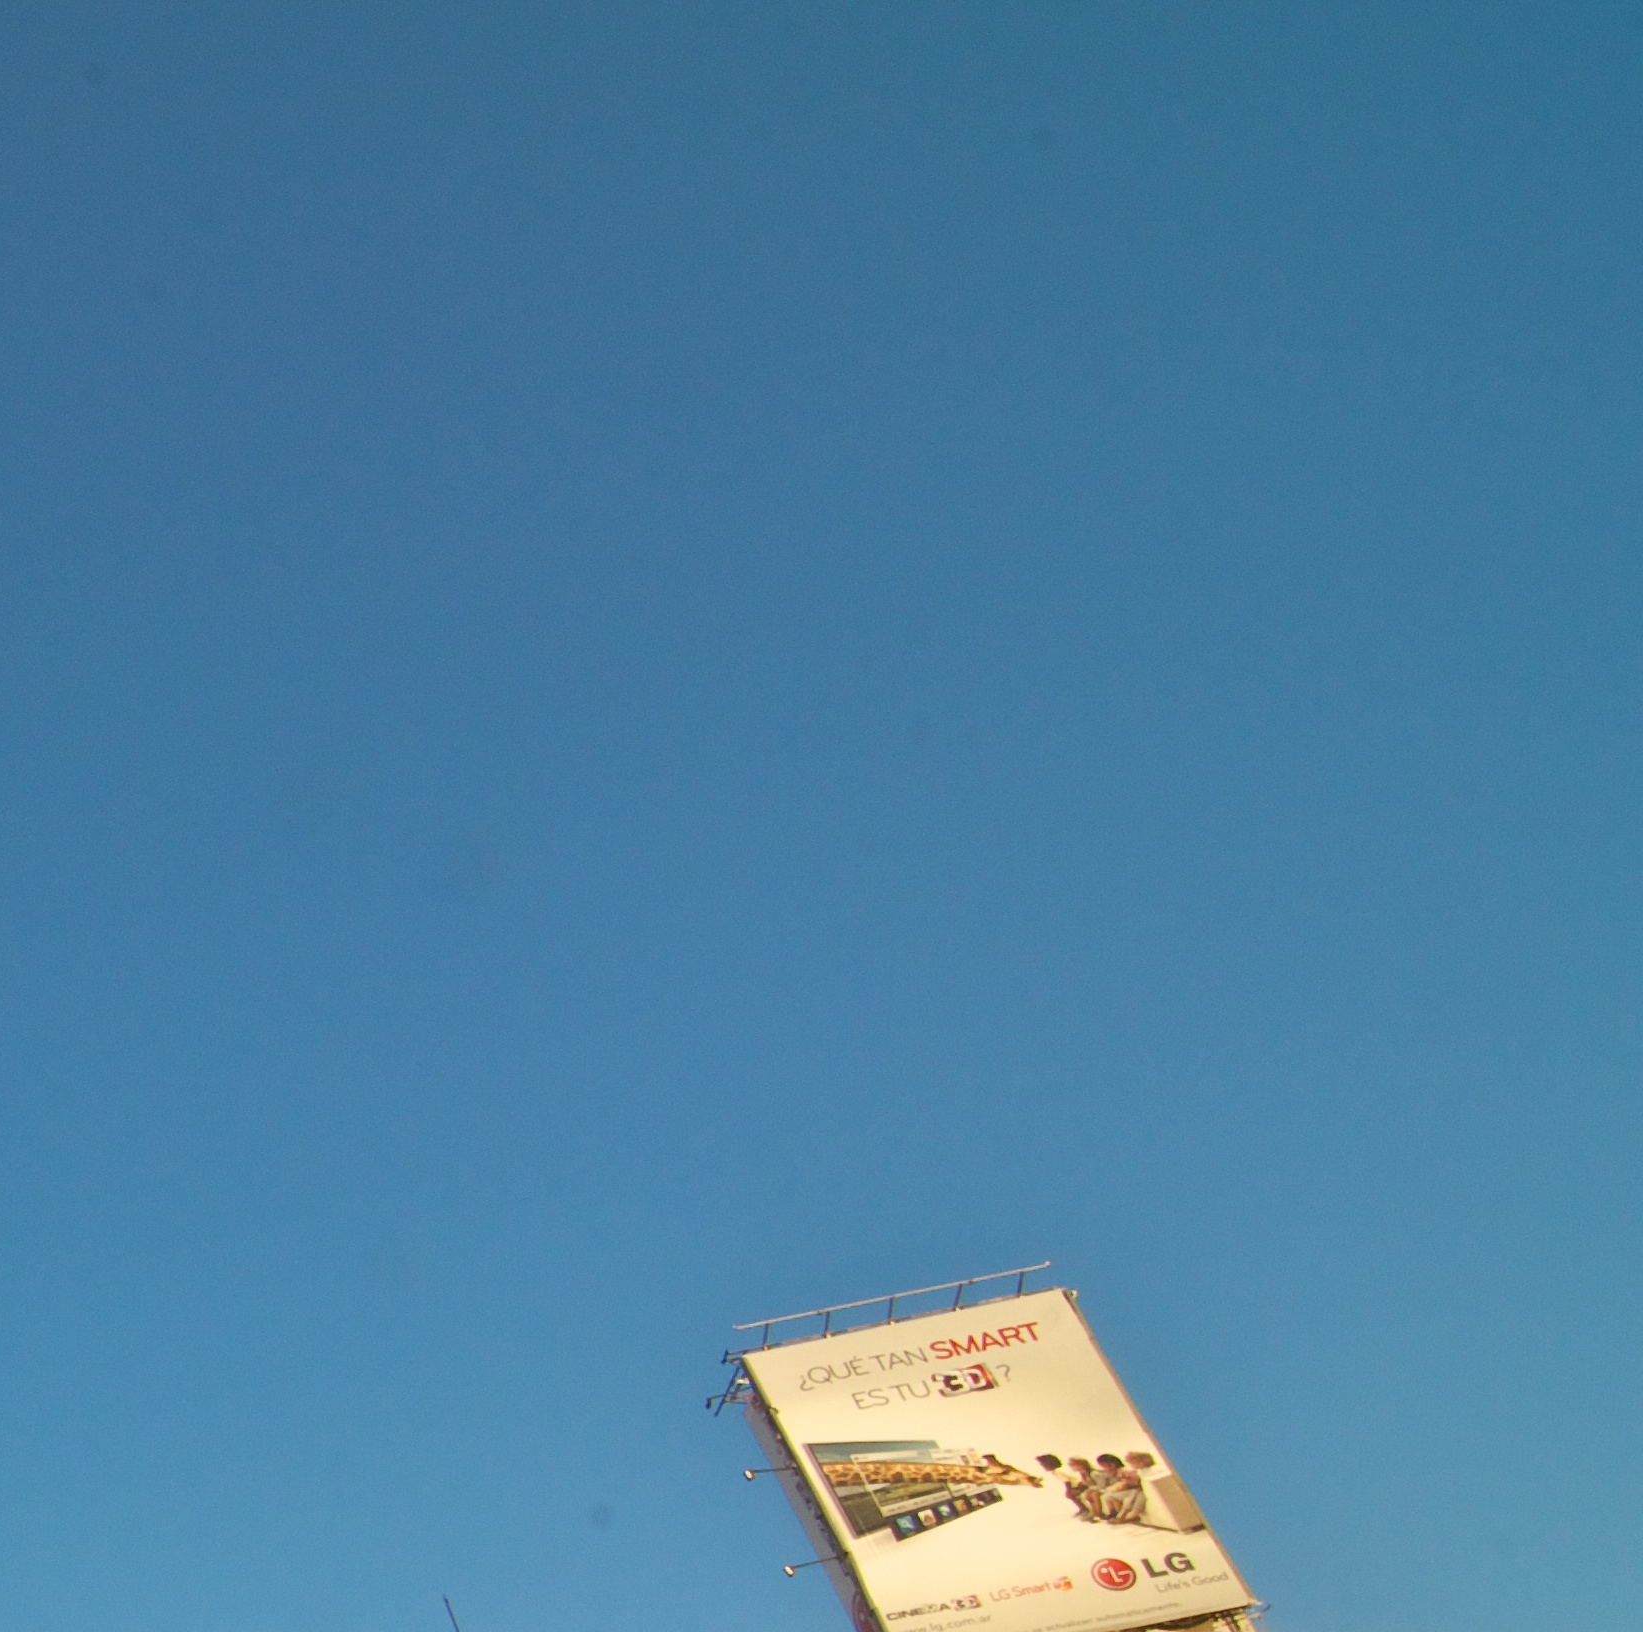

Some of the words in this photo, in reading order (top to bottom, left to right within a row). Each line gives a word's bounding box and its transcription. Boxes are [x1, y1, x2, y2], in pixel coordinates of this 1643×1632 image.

[799, 1357, 870, 1392] ¿QUÉ
[869, 1347, 929, 1372] TAN
[929, 1322, 1039, 1361] SMART
[851, 1387, 890, 1410] ES
[888, 1380, 932, 1402] TU
[1140, 1551, 1196, 1579] LG
[1011, 1581, 1052, 1599] Smart
[1155, 1577, 1191, 1594] Life's
[1192, 1571, 1230, 1590] Good
